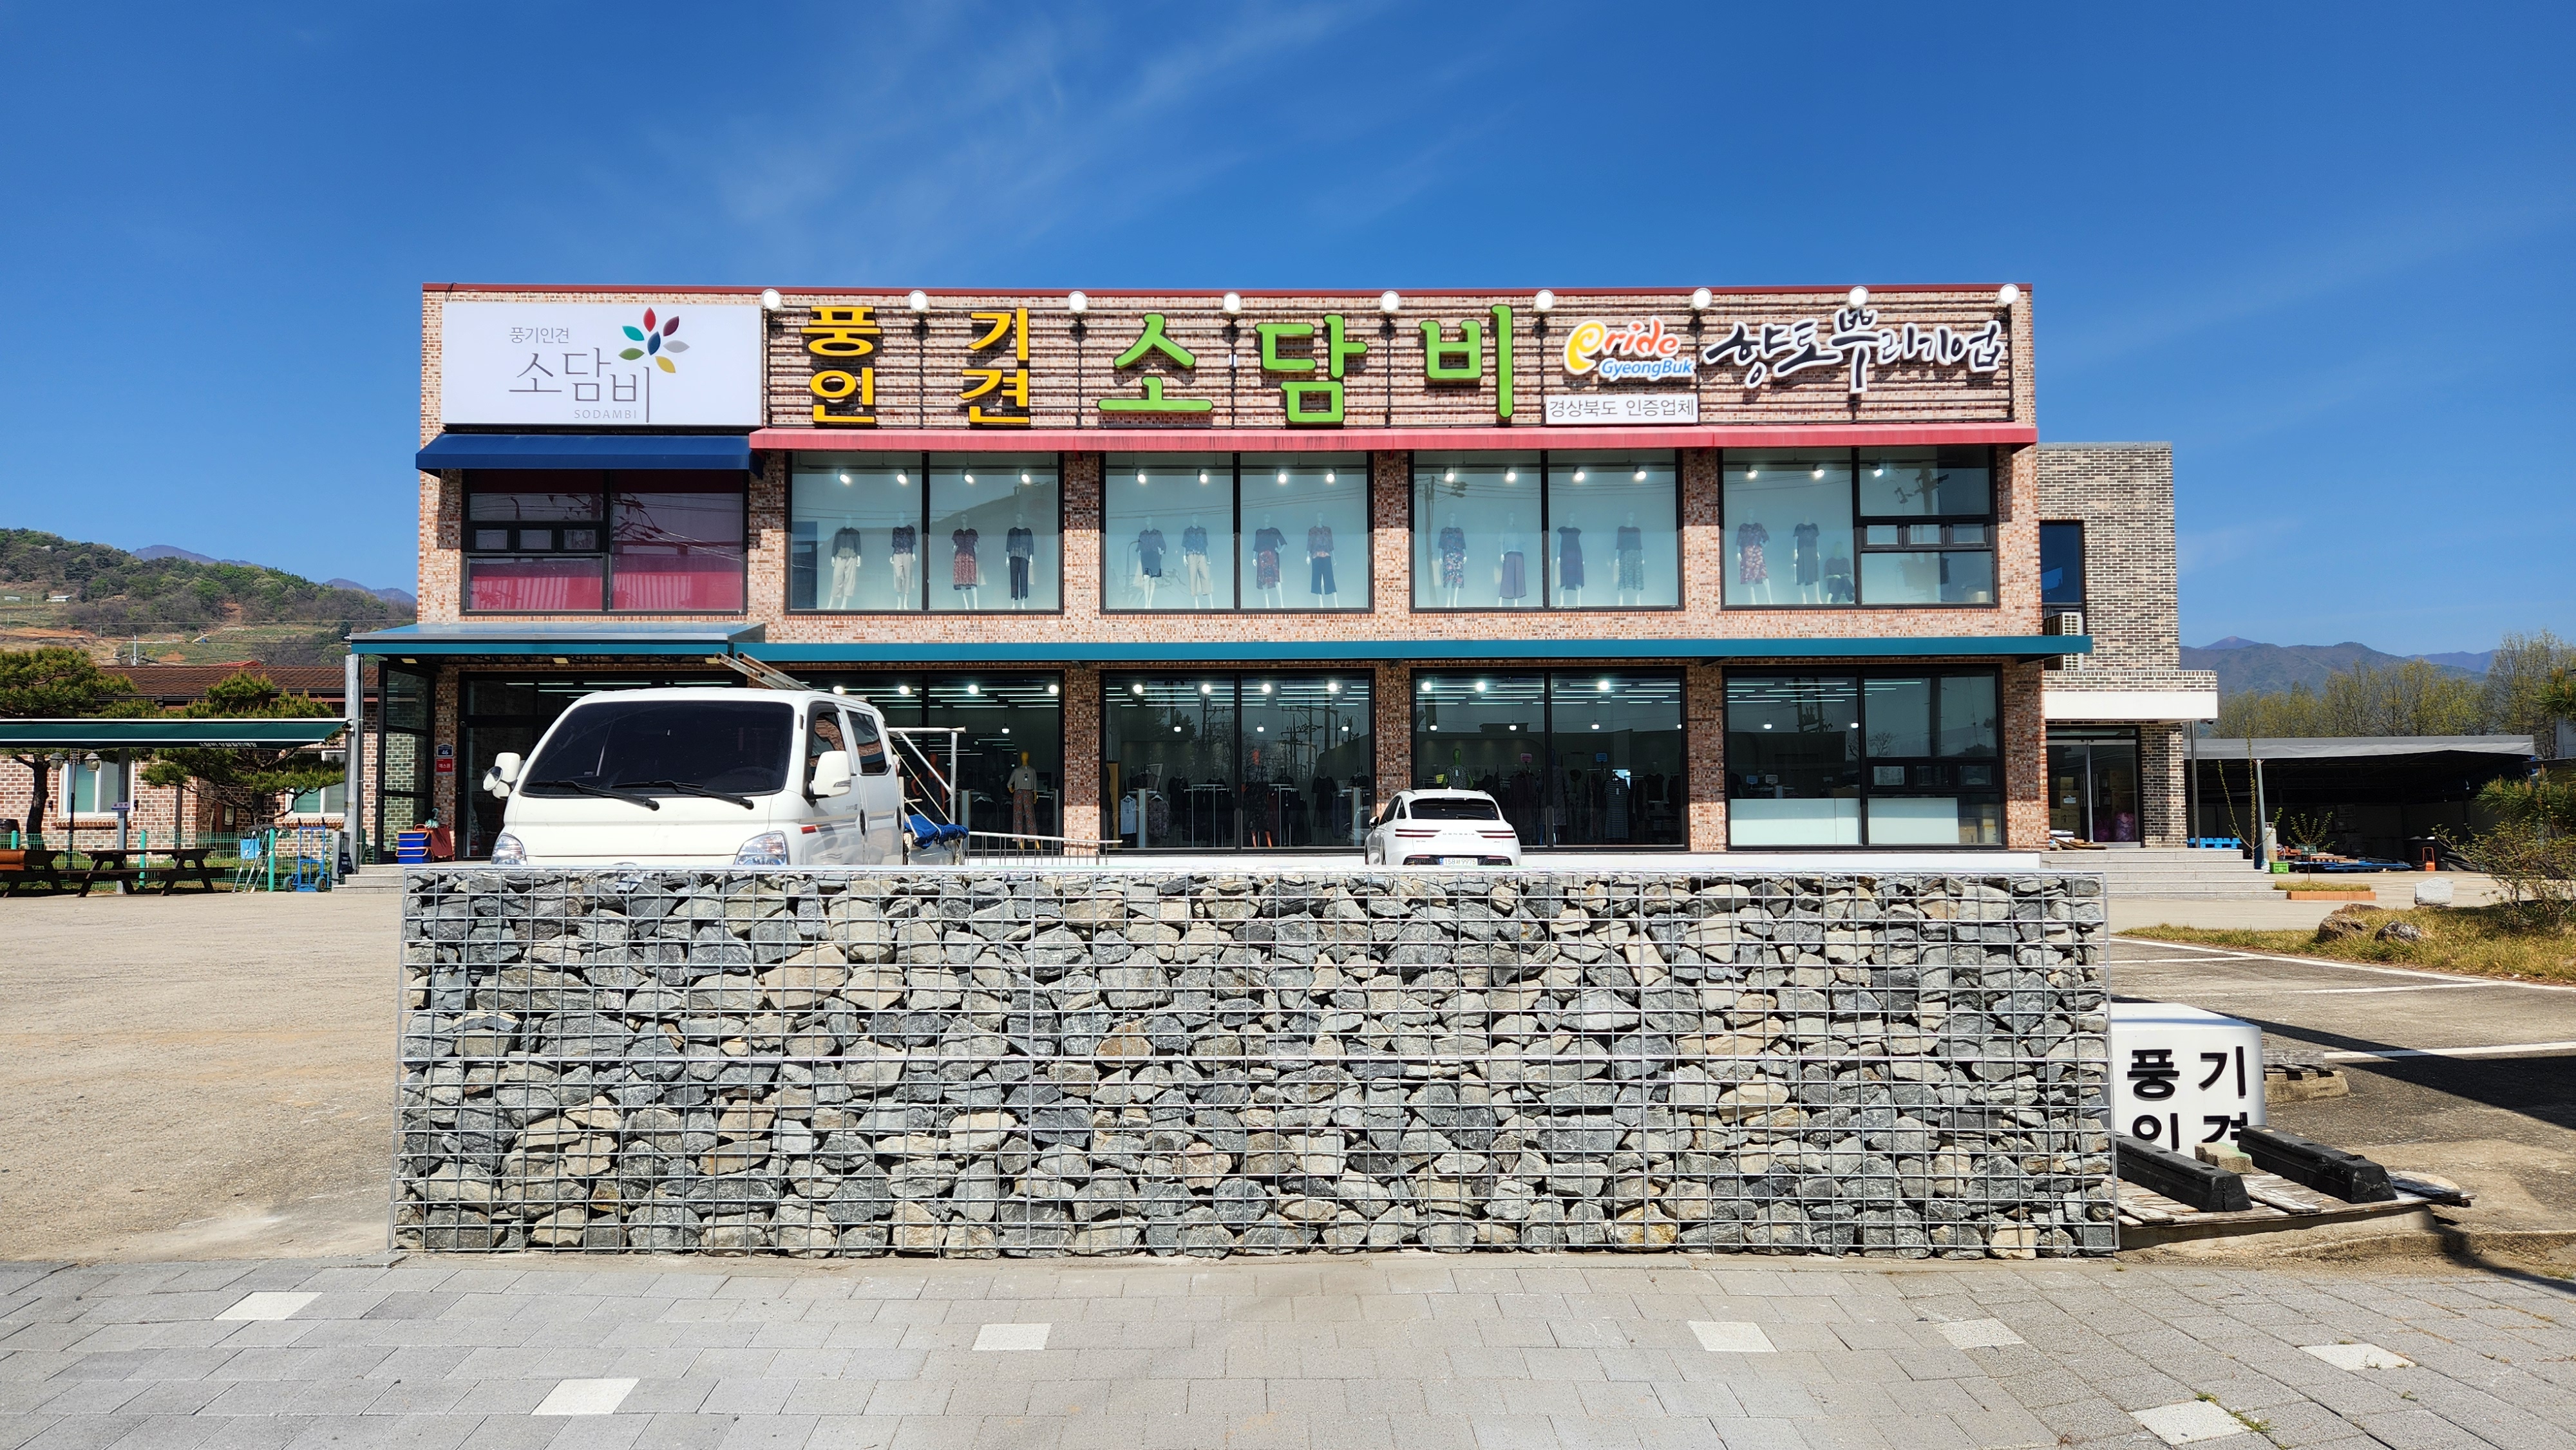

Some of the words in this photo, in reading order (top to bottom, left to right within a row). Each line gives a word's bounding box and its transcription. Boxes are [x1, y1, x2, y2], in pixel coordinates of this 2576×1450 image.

[509, 327, 569, 344] 풍기인견
[1097, 304, 1513, 424] 소담비
[1600, 358, 1693, 377] GyeongBuk
[508, 347, 650, 424] 소담비
[573, 409, 637, 419] SODAMBI
[1549, 400, 1618, 418] 경상북도
[1625, 398, 1694, 417] 인증업체
[2126, 1046, 2246, 1101] 풍기
